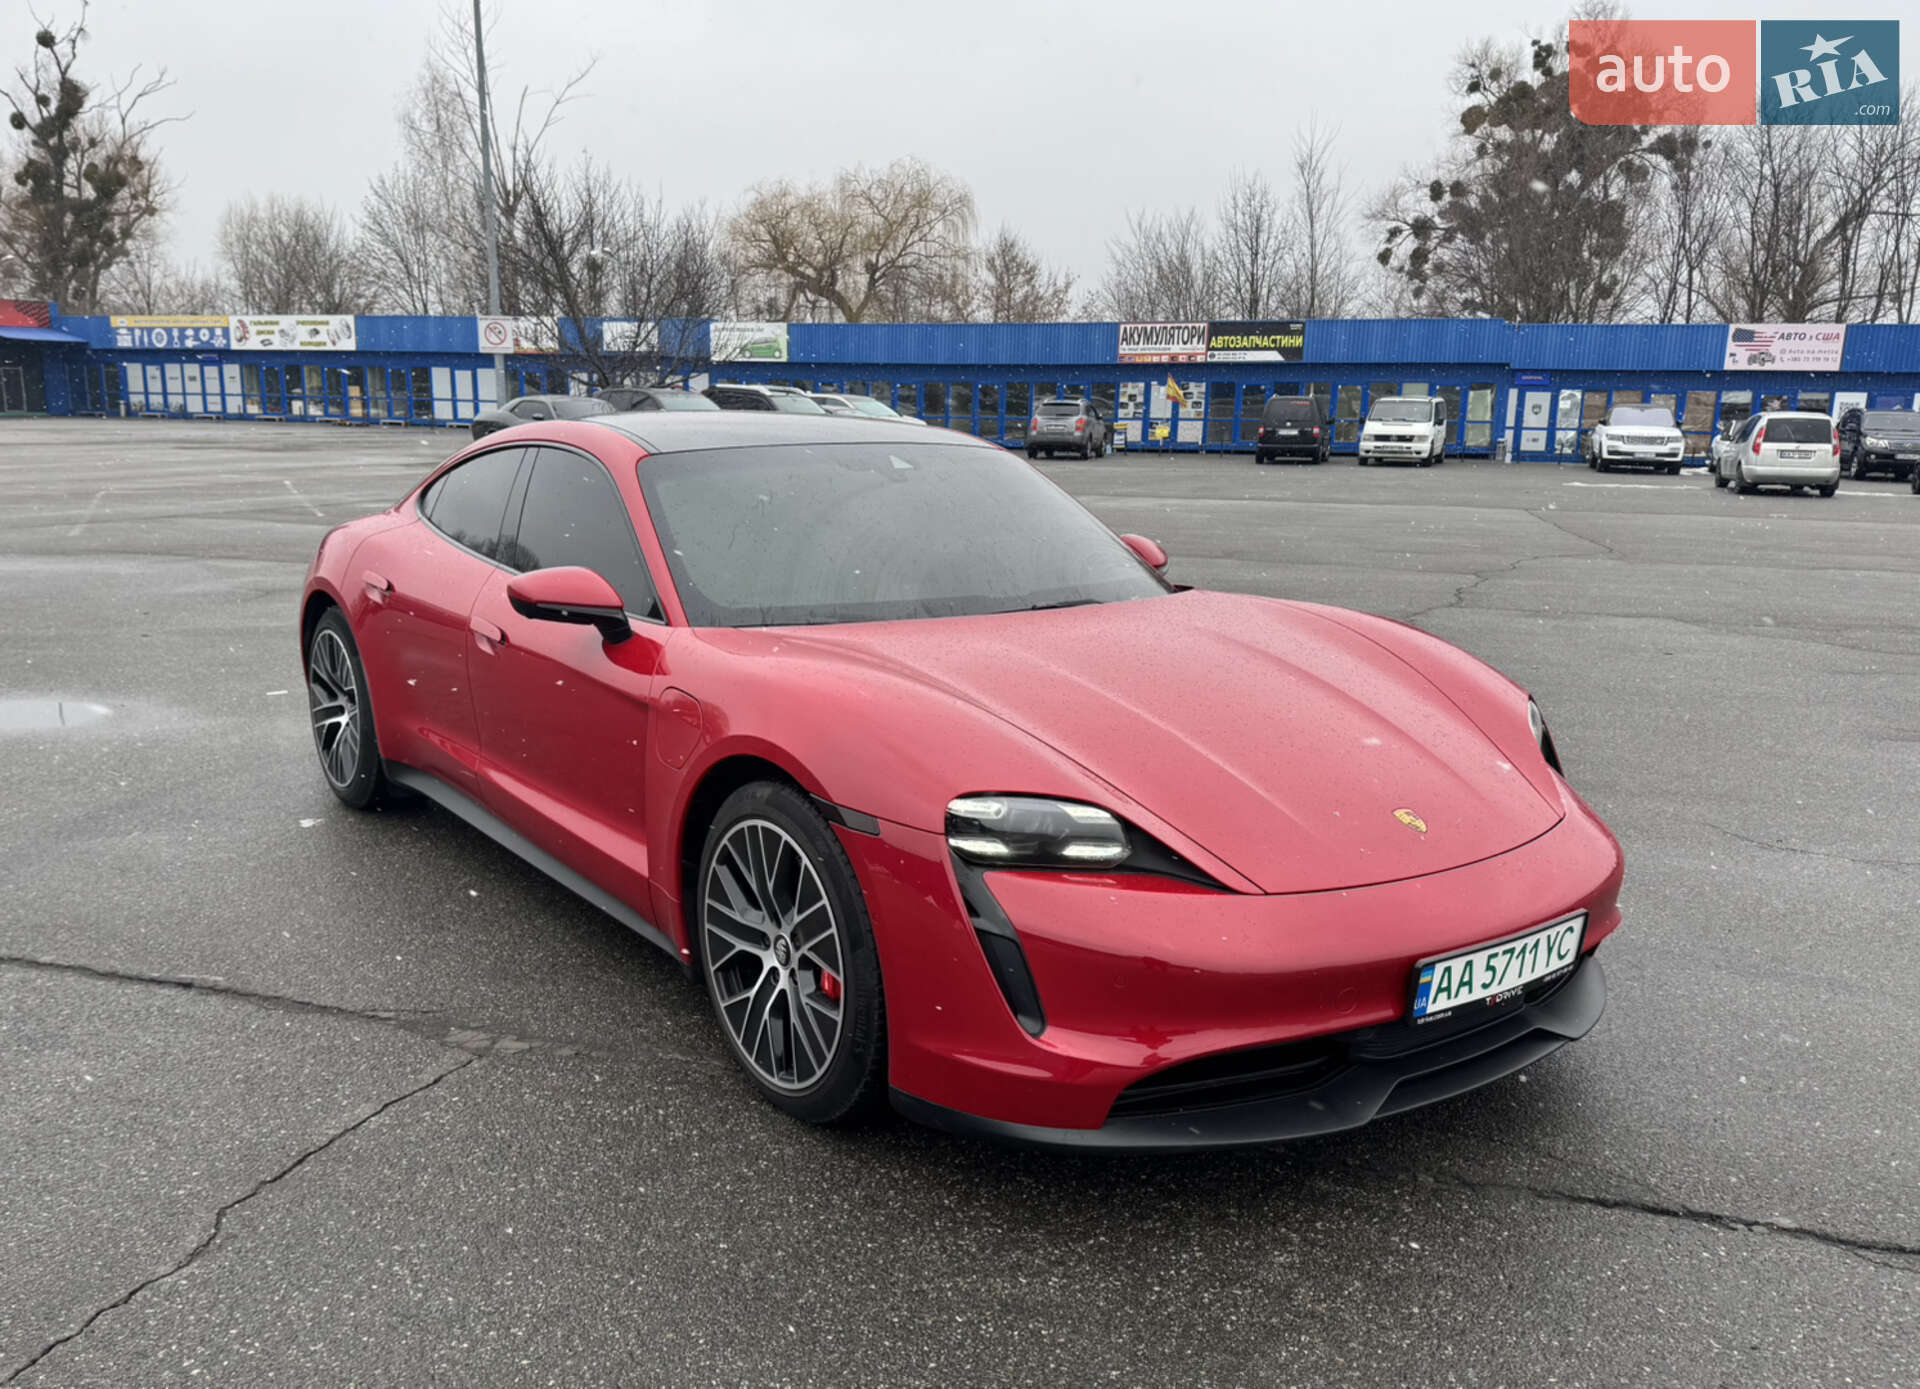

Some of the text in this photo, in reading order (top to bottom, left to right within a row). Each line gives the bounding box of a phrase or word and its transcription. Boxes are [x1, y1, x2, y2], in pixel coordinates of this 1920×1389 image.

[1120, 324, 1207, 346] АКУМУЛЯТОРИ
[1209, 335, 1303, 349] АВТОЗАПЧАСТИНИ
[1778, 332, 1807, 341] АВТО
[1815, 332, 1840, 341] США
[1431, 925, 1574, 1005] AA 5711 YC
[1414, 997, 1427, 1010] UA
